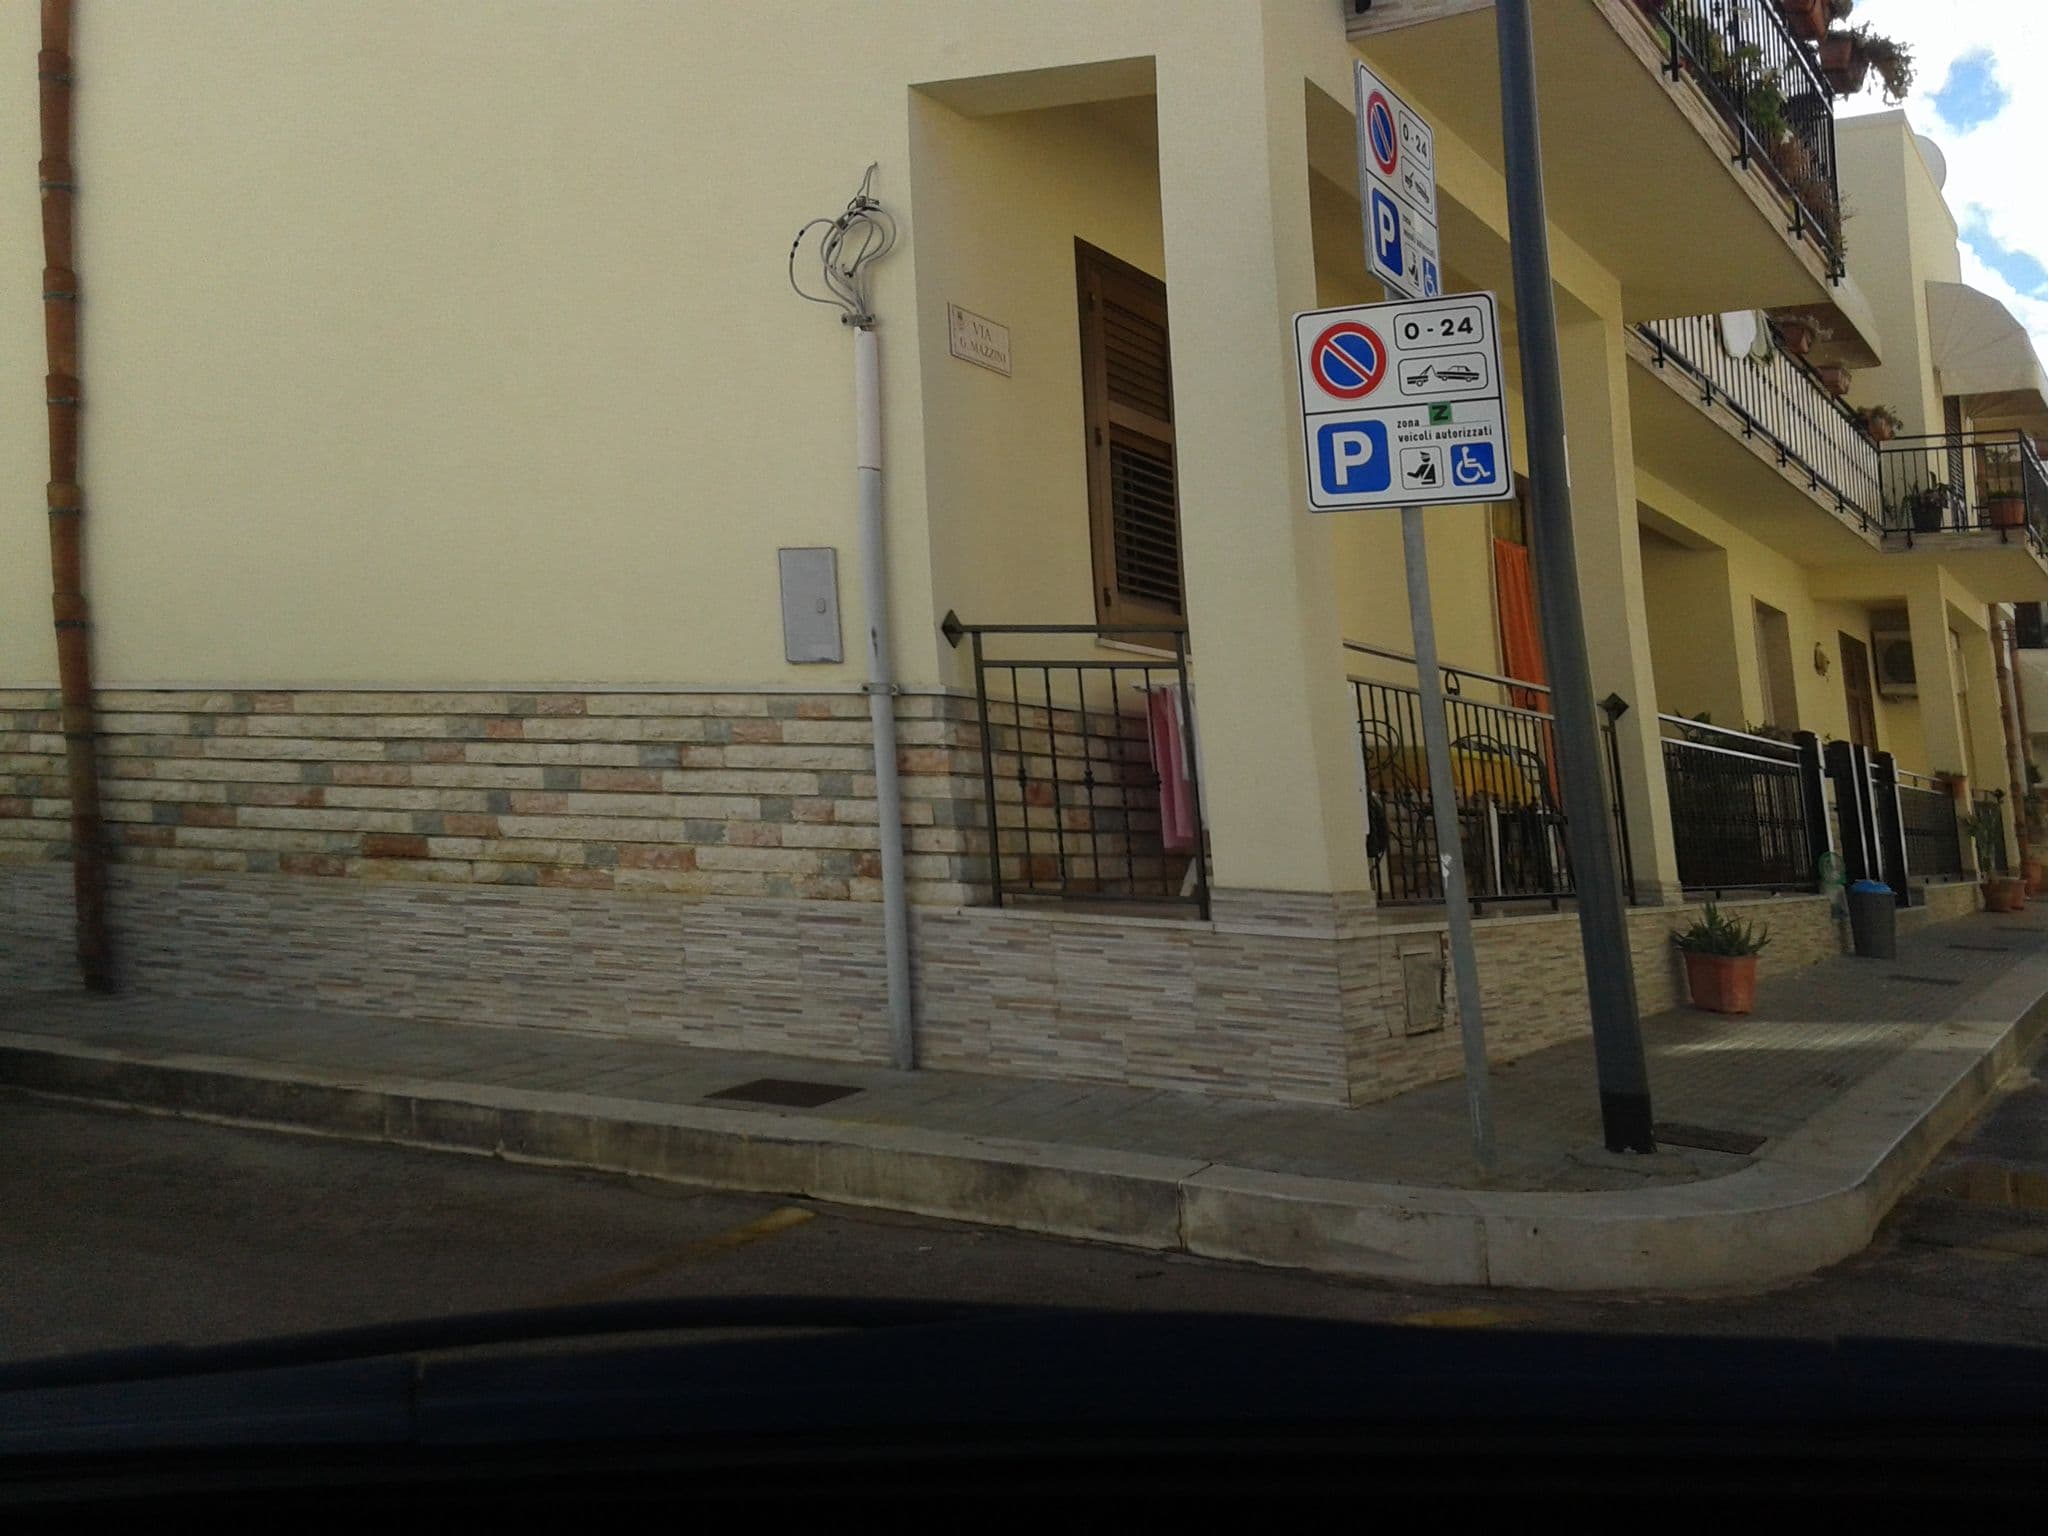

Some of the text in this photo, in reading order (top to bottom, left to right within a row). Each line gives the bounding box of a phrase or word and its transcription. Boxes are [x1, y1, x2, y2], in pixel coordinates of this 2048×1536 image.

[1416, 135, 1428, 157] 24
[1378, 200, 1396, 257] P
[972, 321, 992, 343] VIA
[1404, 322, 1420, 340] 0
[1440, 317, 1474, 337] 24
[1397, 405, 1449, 429] zona Z
[1398, 426, 1493, 443] veicoli autorizzati
[1332, 430, 1373, 486] P
